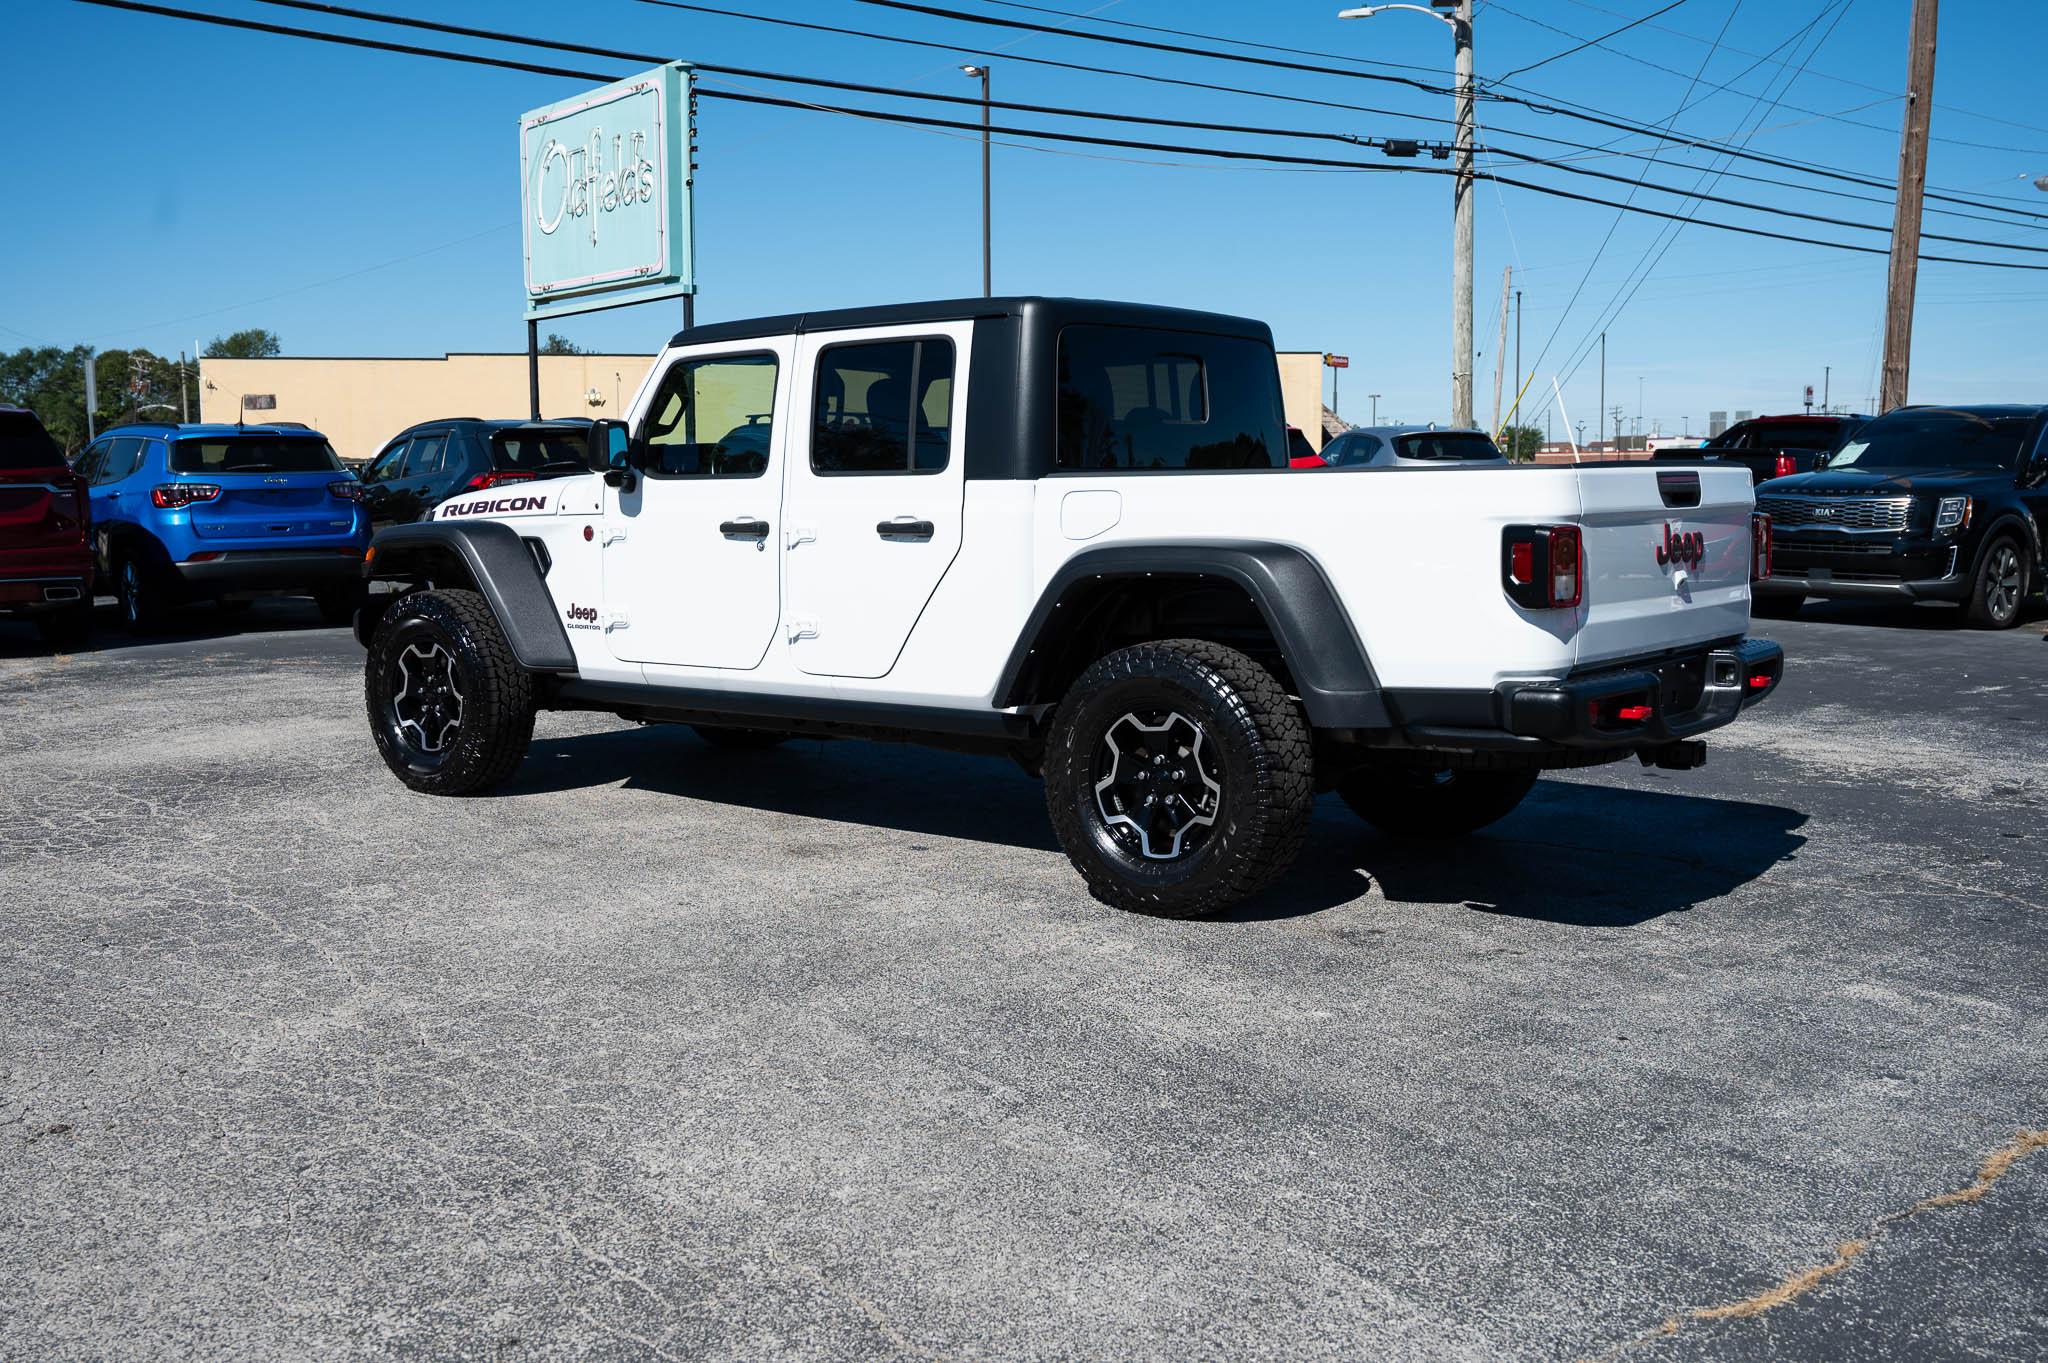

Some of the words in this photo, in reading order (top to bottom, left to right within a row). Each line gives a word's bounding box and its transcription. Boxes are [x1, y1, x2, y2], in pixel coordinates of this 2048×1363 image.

[442, 496, 547, 517] RUBICON
[1815, 508, 1830, 517] KIA
[1656, 522, 1704, 571] Jeep
[567, 603, 598, 623] Jeep
